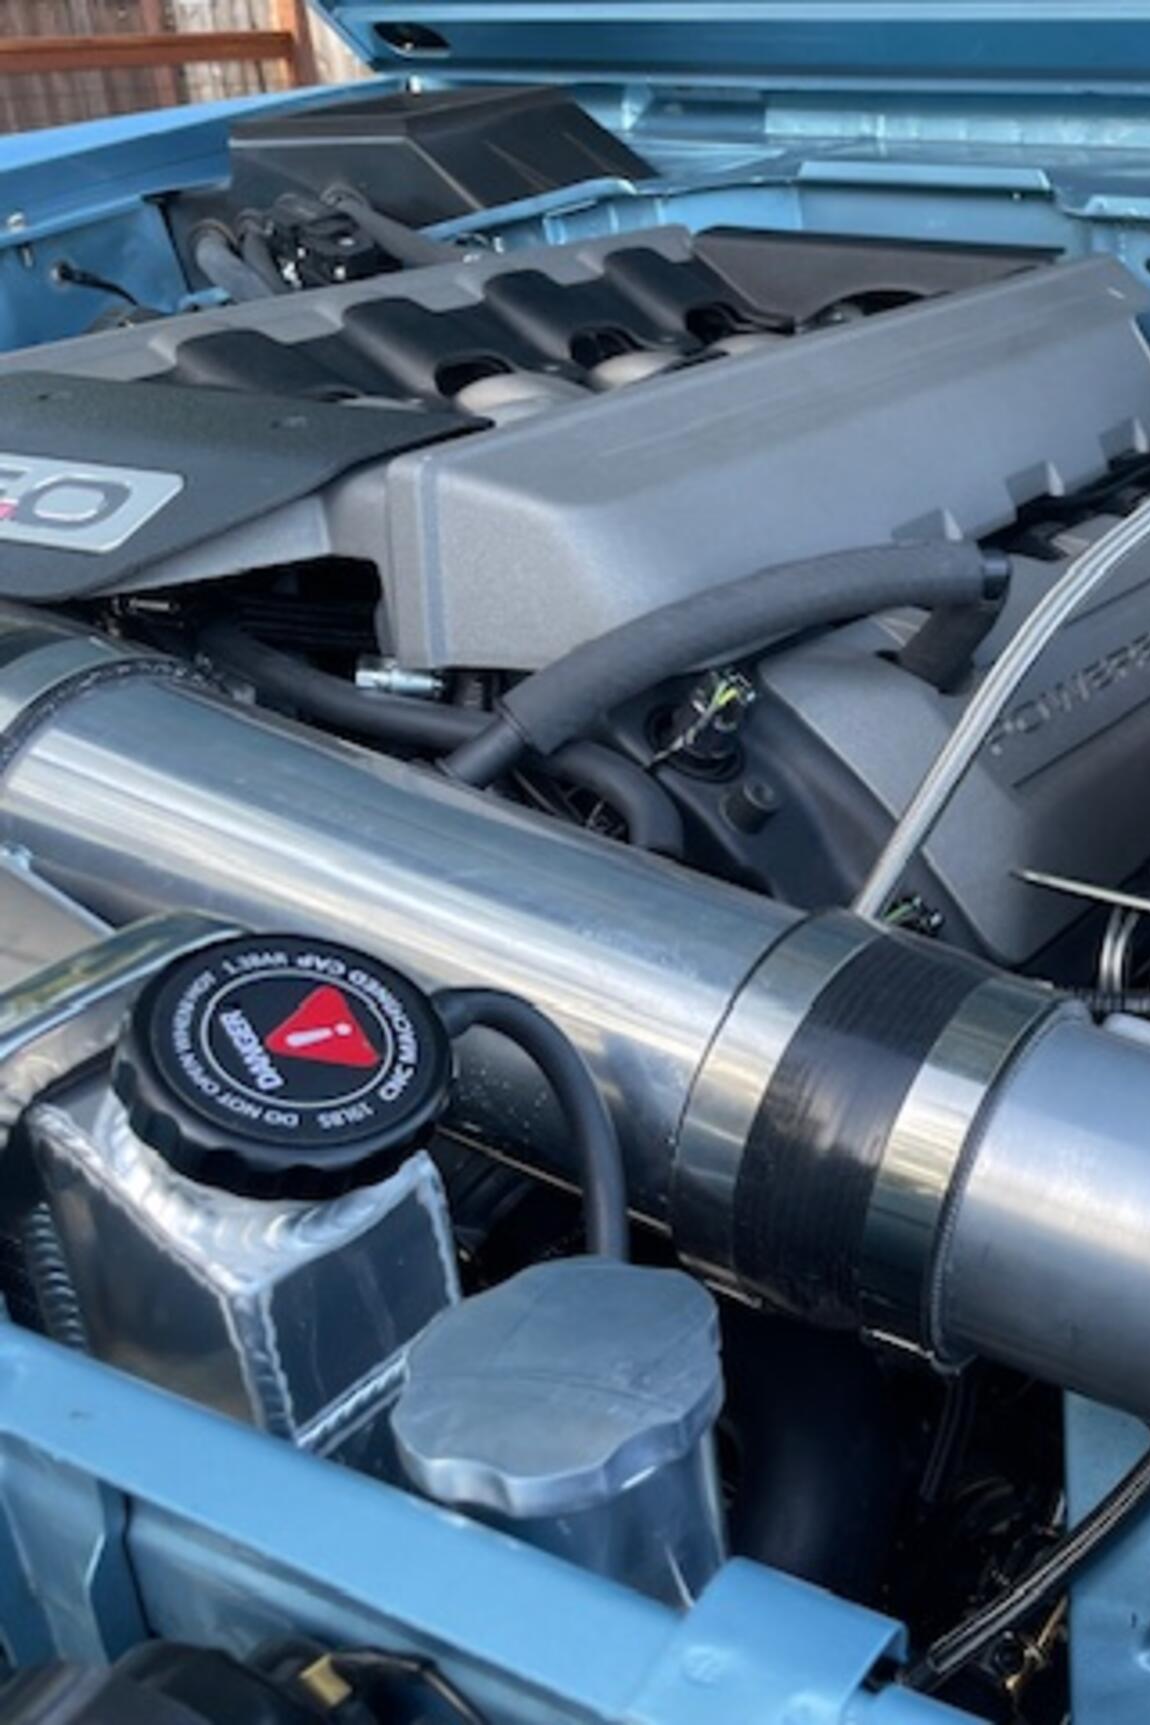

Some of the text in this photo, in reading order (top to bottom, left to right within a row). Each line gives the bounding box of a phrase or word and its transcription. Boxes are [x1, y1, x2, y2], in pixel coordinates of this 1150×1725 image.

[297, 953, 345, 975] CAP
[220, 1009, 285, 1091] DANGER
[179, 1053, 220, 1096] OPEN
[215, 1091, 263, 1119] NOT
[264, 1108, 299, 1128] DO
